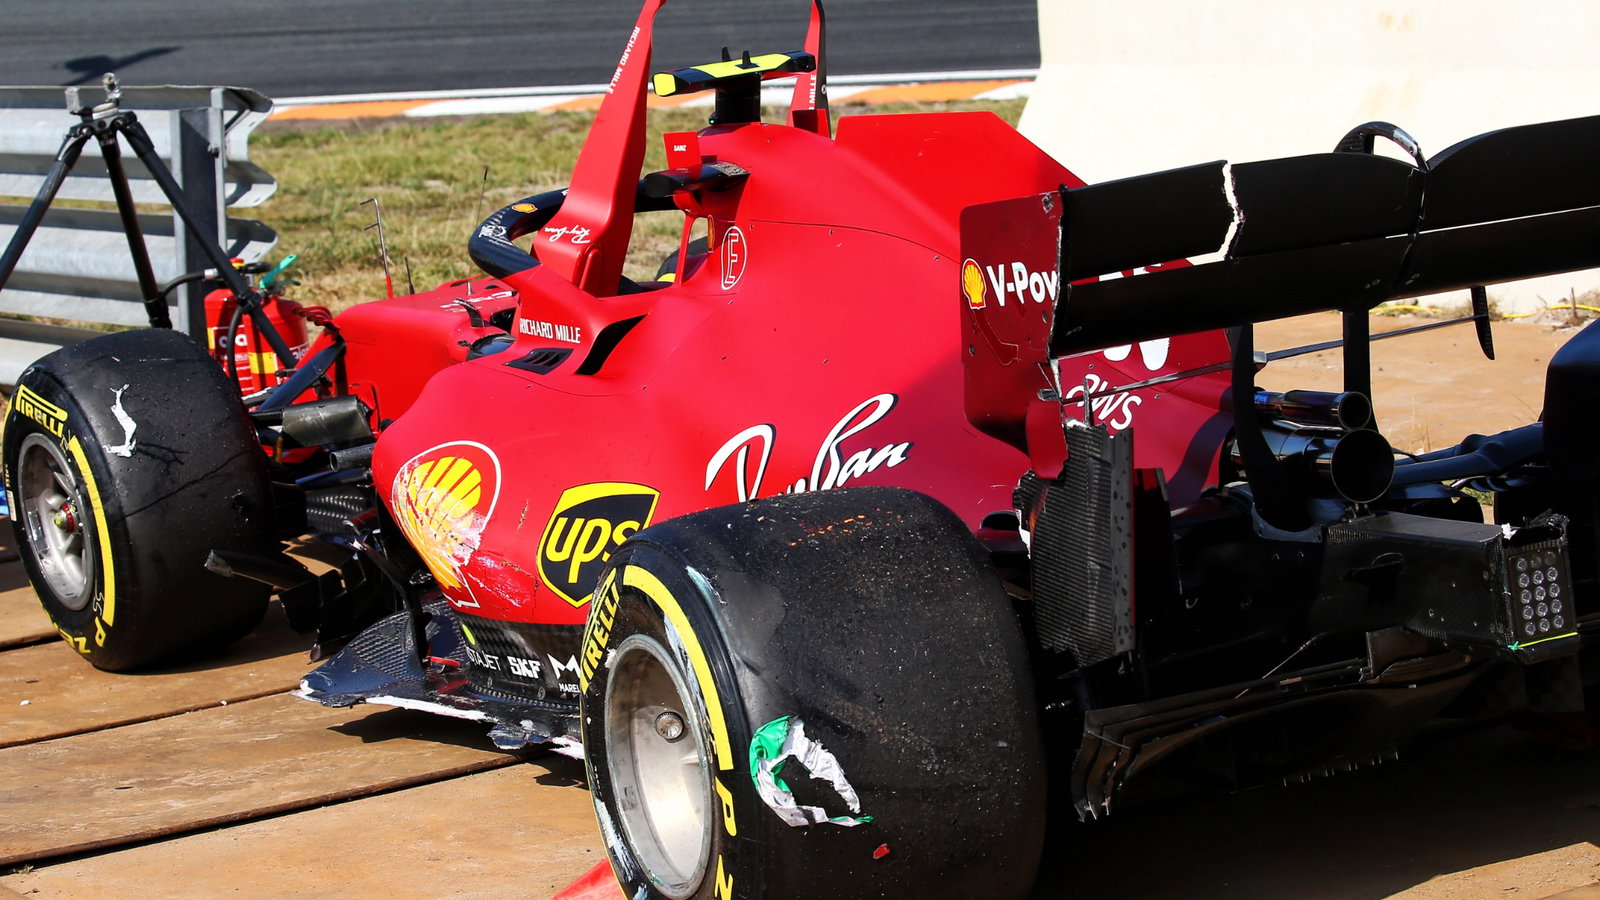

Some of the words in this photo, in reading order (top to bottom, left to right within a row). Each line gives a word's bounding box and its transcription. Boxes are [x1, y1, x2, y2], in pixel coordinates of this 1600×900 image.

[620, 26, 640, 66] RICHARD
[607, 66, 623, 95] MILLE
[808, 74, 816, 104] MILLE
[986, 261, 1058, 307] V-Pow
[519, 318, 553, 339] RICHARD
[555, 324, 581, 344] MILLE
[15, 384, 69, 438] PIRELLI
[507, 655, 541, 679] SKF
[559, 683, 580, 693] MAREL
